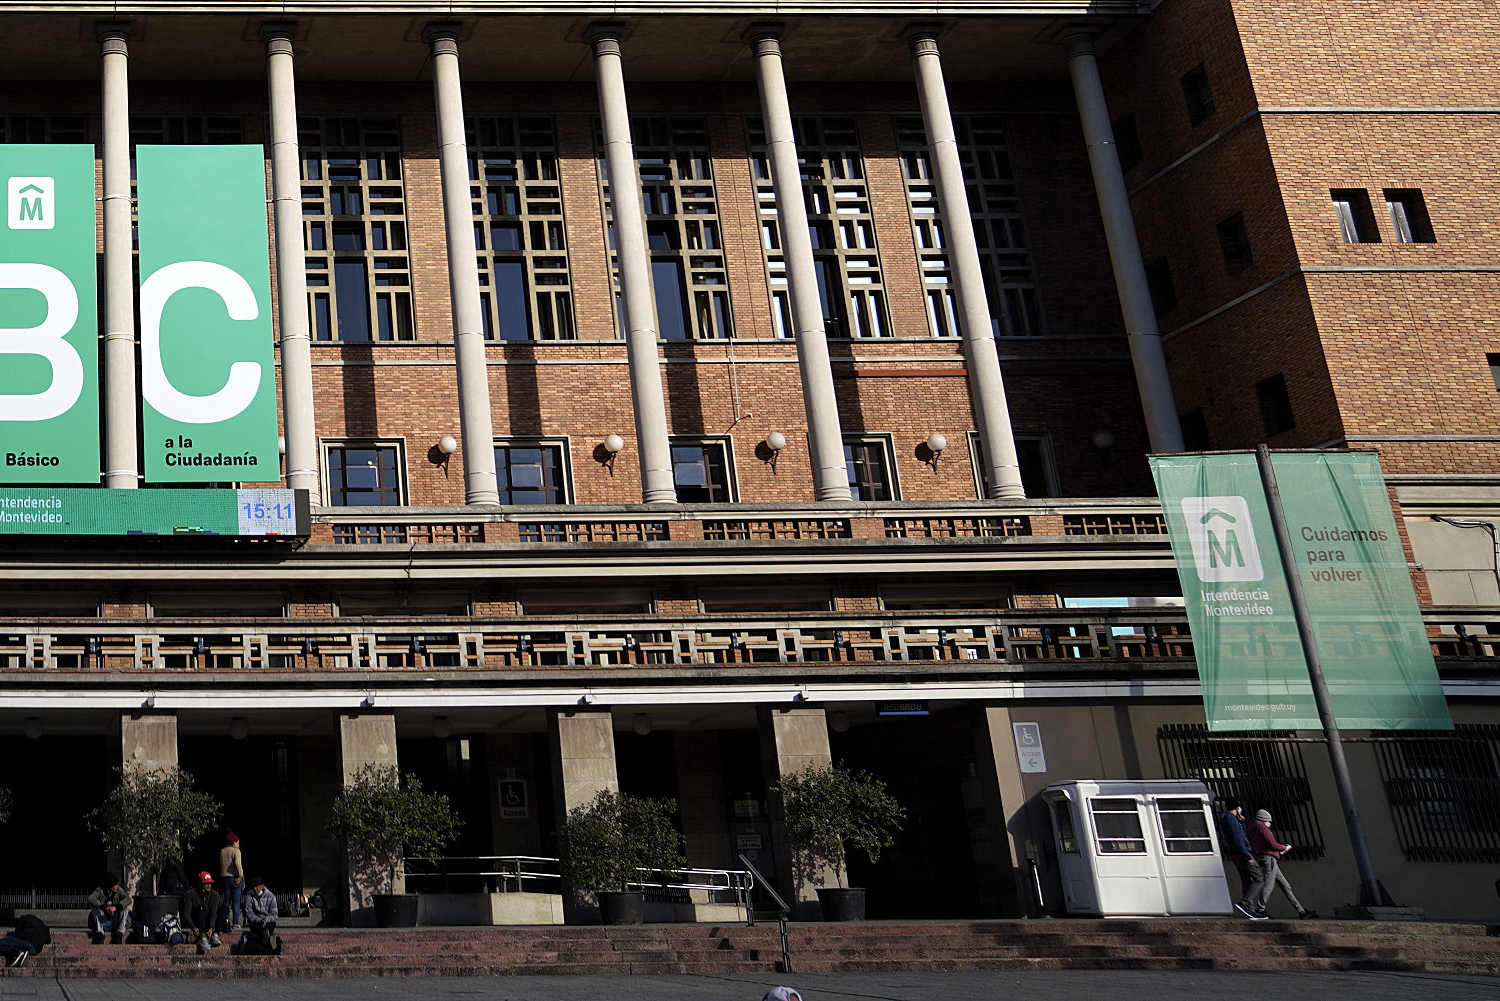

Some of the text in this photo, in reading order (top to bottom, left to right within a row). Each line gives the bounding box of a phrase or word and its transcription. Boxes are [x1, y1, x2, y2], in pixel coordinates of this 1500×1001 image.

[140, 261, 262, 424] C
[165, 434, 193, 449] a la
[5, 451, 60, 467] Básico
[165, 451, 258, 467] Ciudadanía
[243, 503, 292, 519] 15:11
[1301, 526, 1389, 542] Cuidarnos
[1306, 550, 1346, 566] para
[1310, 566, 1363, 582] volver
[1201, 587, 1270, 602] Intendencia
[1204, 602, 1274, 617] Montevideo
[1224, 703, 1297, 713] montevideo.gub.uy
[1021, 750, 1042, 758] Acceso
[503, 809, 526, 817] Acceso
